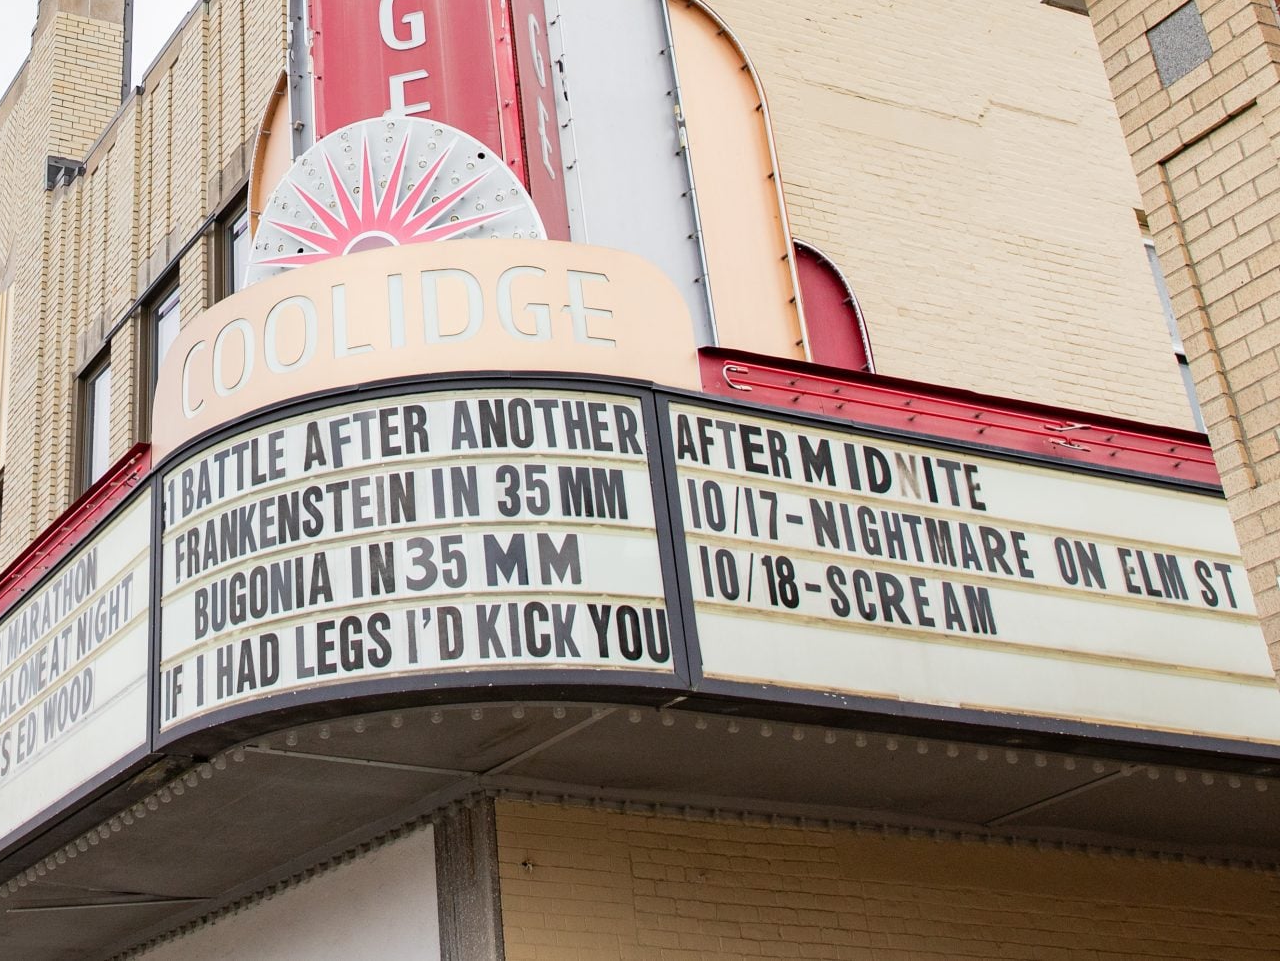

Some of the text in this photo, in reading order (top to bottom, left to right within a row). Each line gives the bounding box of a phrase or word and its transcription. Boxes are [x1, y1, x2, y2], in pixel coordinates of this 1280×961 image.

[182, 265, 617, 419] COOLIDGE
[181, 430, 286, 518] BATTLE
[304, 405, 430, 471] AFTER
[452, 398, 643, 455] ANOTHER
[175, 470, 418, 585] FRANKENSTEIN
[432, 466, 479, 519] IN
[1054, 536, 1107, 590] ON
[1118, 547, 1189, 601] ELM
[1195, 559, 1239, 609] ST
[7, 547, 98, 666] MARATHON
[194, 552, 333, 641] BUGONIA
[351, 542, 395, 598] IN
[405, 535, 468, 591] 35
[0, 645, 47, 725] ALONE
[50, 624, 73, 681] AT
[76, 571, 134, 661] NIGHT
[165, 602, 671, 721] IF I HAD LEGS I'D KICK YOU
[16, 710, 37, 766] ED
[43, 666, 94, 744] WOOD
